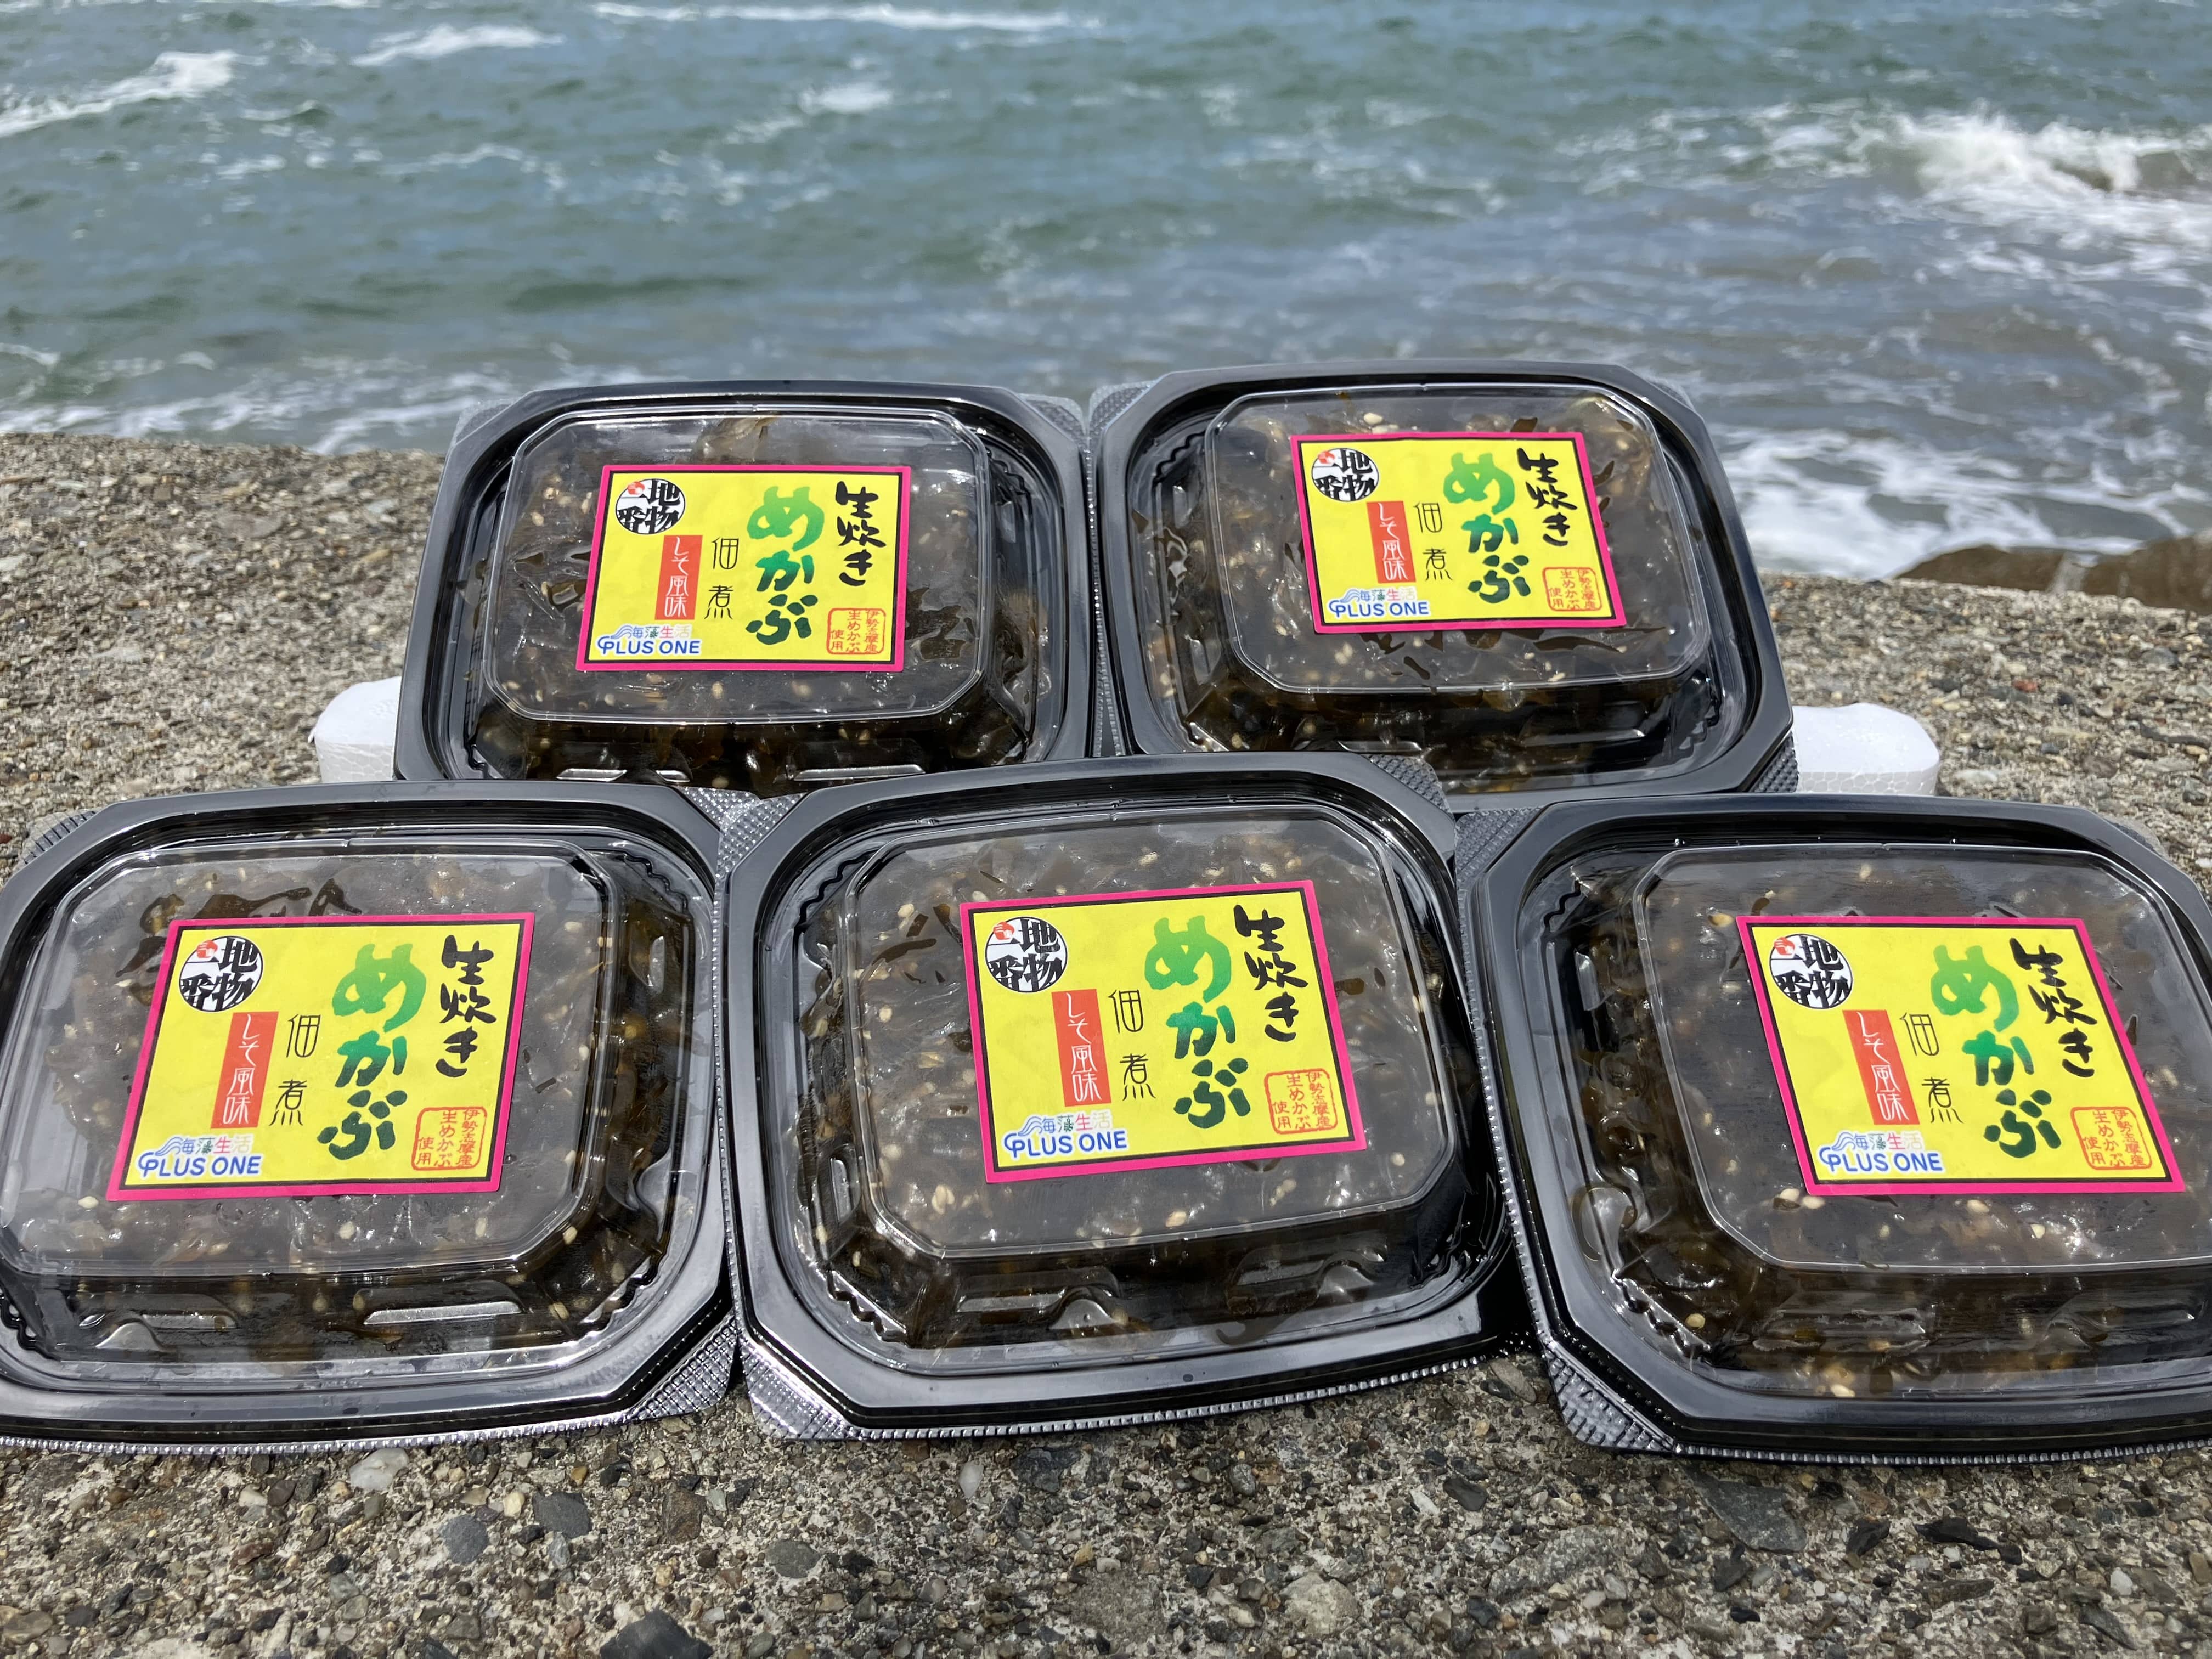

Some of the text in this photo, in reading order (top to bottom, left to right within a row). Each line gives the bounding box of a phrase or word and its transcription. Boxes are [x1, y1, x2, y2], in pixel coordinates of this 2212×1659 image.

[836, 481, 886, 586] 生炊き
[1379, 502, 1408, 581] しそ風味
[1413, 502, 1452, 581] 佃煮
[1443, 453, 1530, 603] めかぶ
[1517, 448, 1577, 546] 生炊き
[664, 537, 690, 618] しそ風味
[704, 537, 738, 620] 佃煮
[746, 487, 824, 645] めかぶ
[1329, 600, 1429, 618] PLUS ONE
[1549, 588, 1564, 607] 使用
[598, 637, 699, 654] PLUS ONE
[831, 630, 844, 651] 使用
[436, 934, 496, 1078] 生炊き
[1144, 915, 1251, 1129] めかぶ
[1233, 905, 1308, 1042] 生炊き
[2010, 938, 2097, 1077] 生炊き
[222, 1014, 259, 1125] しそ風味
[269, 1014, 321, 1126] 佃煮
[317, 943, 426, 1160] めかぶ
[1067, 992, 1102, 1103] しそ風味
[1108, 989, 1156, 1102] 佃煮
[1858, 1012, 1907, 1121] しそ風味
[1900, 1012, 1964, 1124] 佃煮
[1931, 945, 2061, 1159] めかぶ
[416, 1137, 435, 1165] 使用
[1004, 1130, 1127, 1159] PLUS ONE
[1272, 1098, 1291, 1128] 使用
[1819, 1148, 1943, 1172] PLUS ONE
[2083, 1136, 2107, 1164] 使用
[138, 1154, 261, 1178] PLUS ONE
